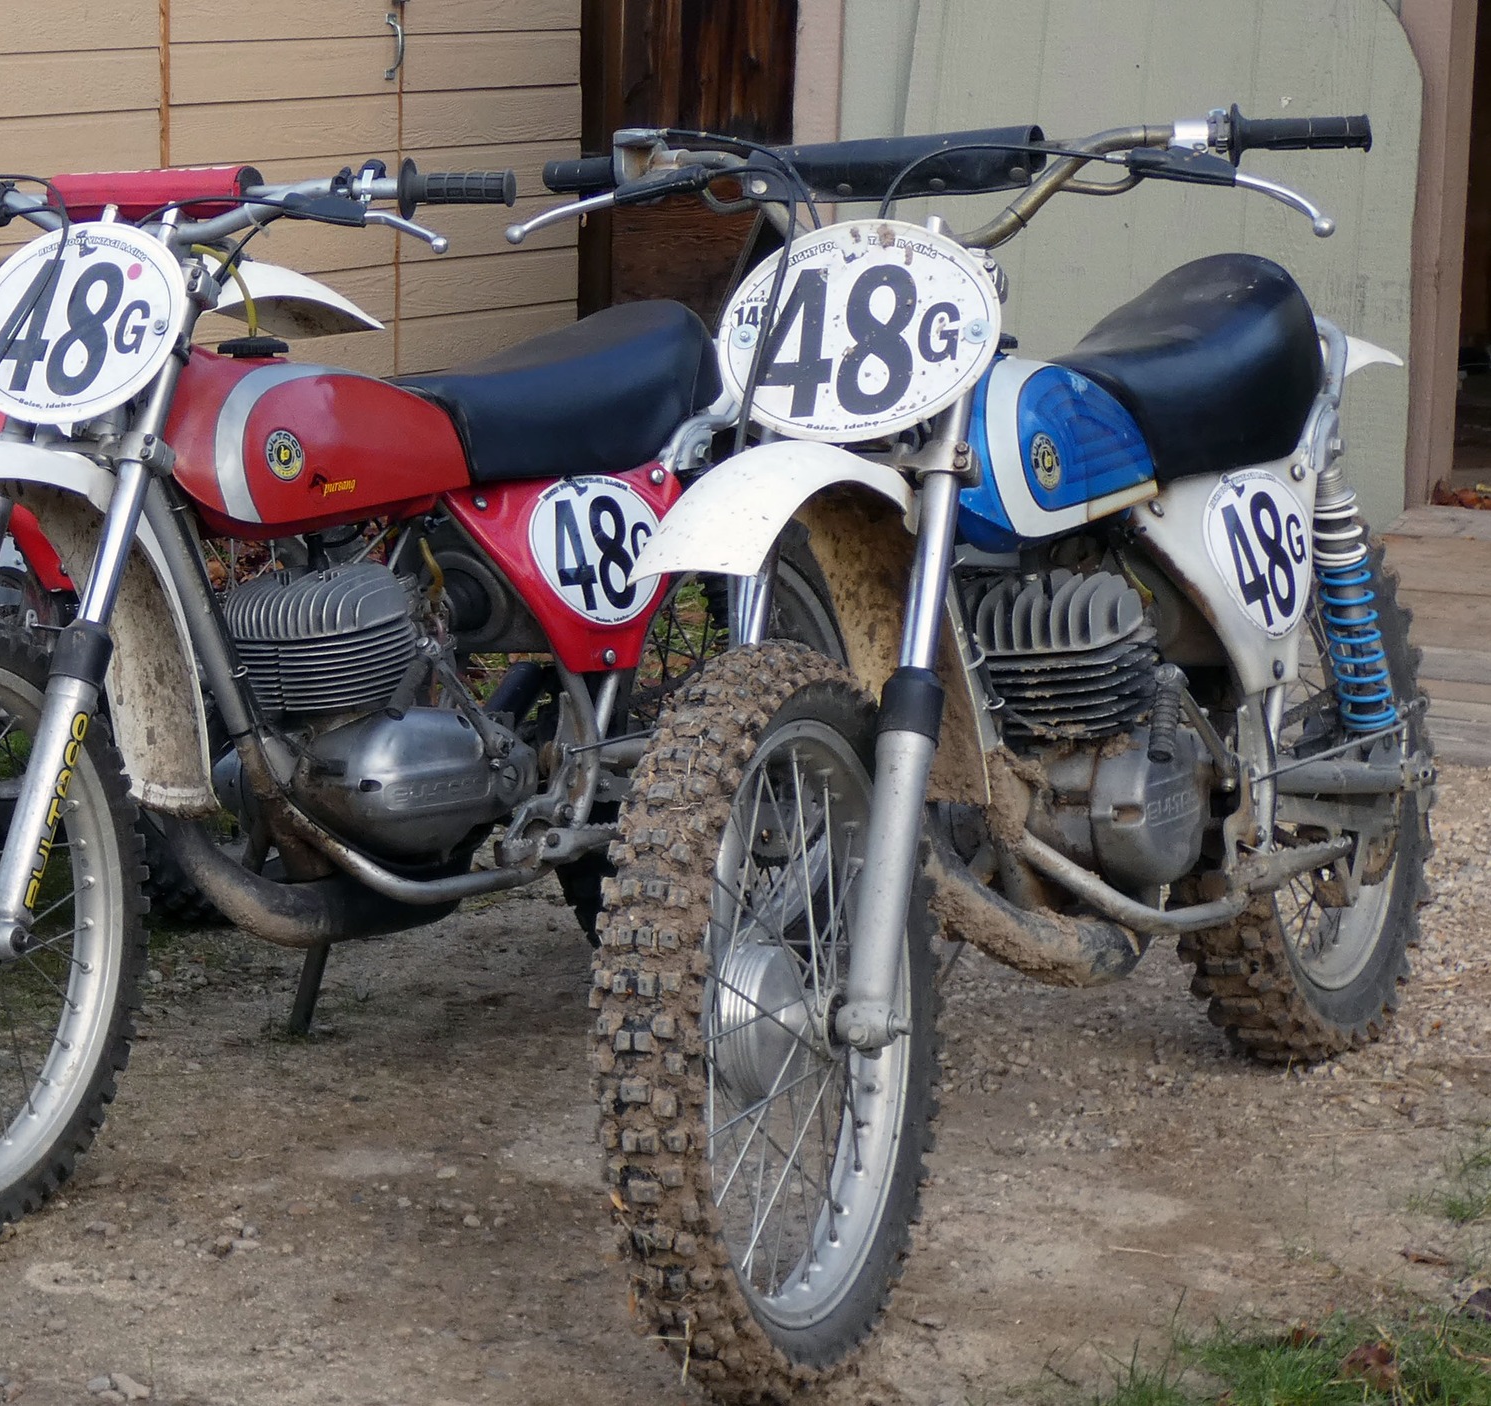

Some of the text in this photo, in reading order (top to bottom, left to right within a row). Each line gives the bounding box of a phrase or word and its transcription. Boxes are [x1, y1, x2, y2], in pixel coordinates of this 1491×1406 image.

[87, 236, 120, 248] VINTAGE
[120, 242, 147, 262] RACING
[268, 432, 302, 462] BULTACO
[323, 479, 356, 497] pursang
[24, 711, 90, 910] BULTACO
